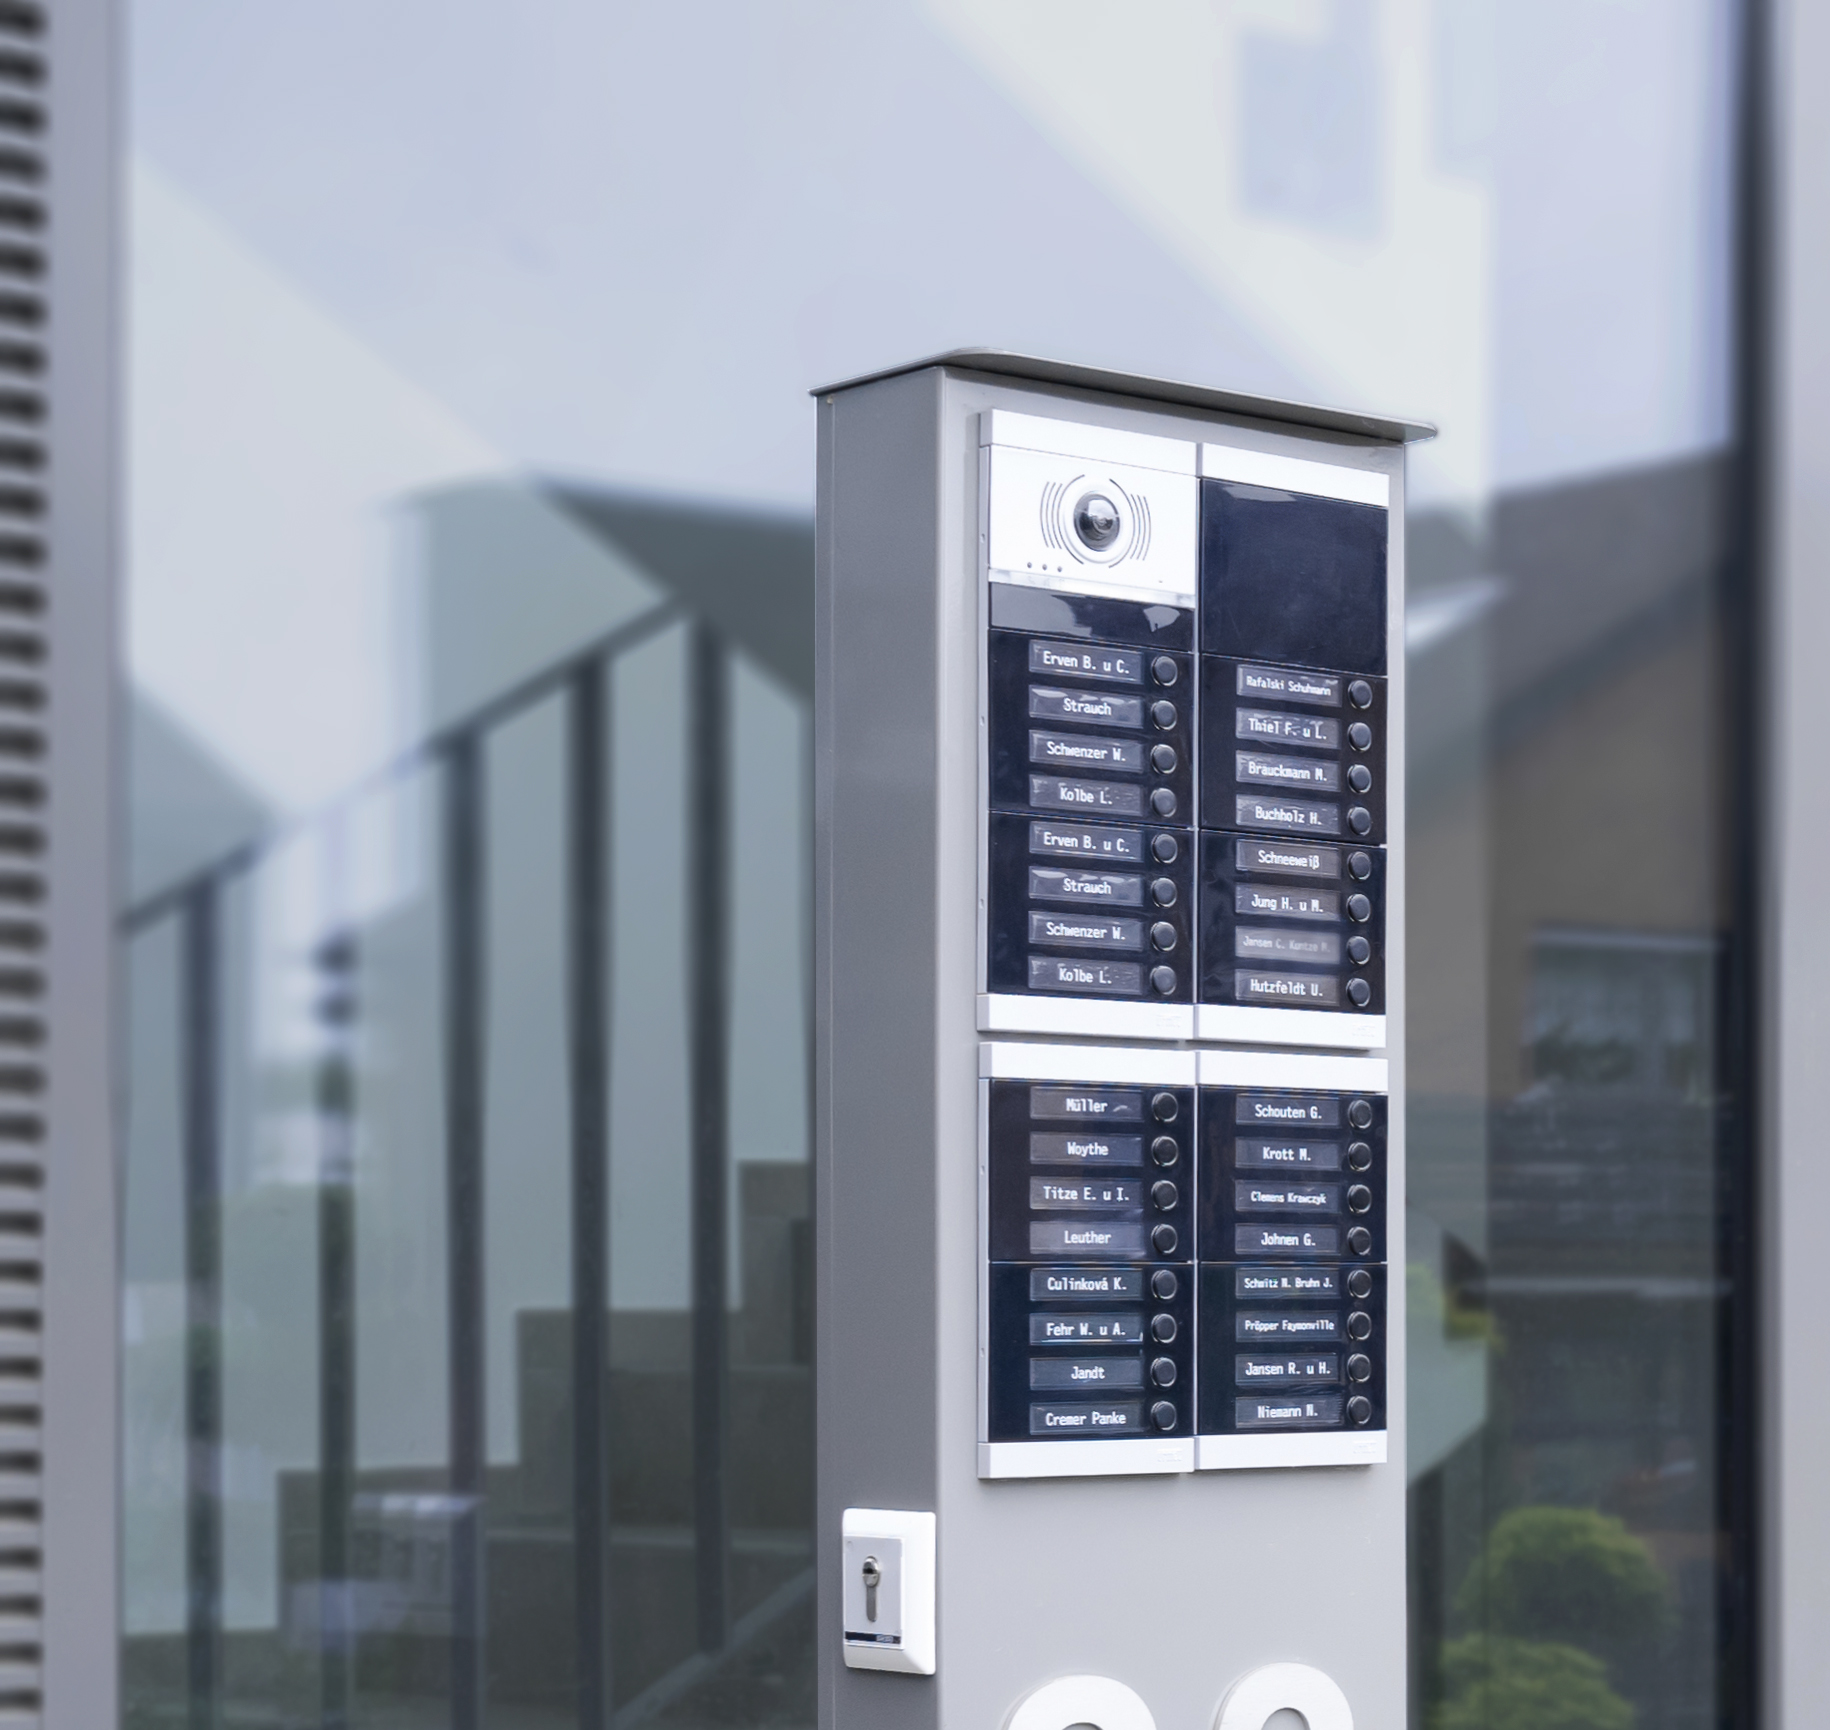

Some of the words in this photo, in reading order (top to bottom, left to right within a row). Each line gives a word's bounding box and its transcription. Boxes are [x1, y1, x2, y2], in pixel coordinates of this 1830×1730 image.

[1043, 651, 1078, 668] Erven
[1083, 655, 1096, 670] B.
[1103, 661, 1111, 671] u
[1116, 659, 1130, 674] C.
[1246, 675, 1285, 690] Rafalski
[1063, 697, 1111, 716] Strauch
[1248, 717, 1279, 734] Thiel
[1303, 729, 1311, 738] u
[1315, 726, 1327, 740] L.
[1047, 741, 1108, 759] Schwenzer
[1112, 747, 1126, 761] W.
[1248, 761, 1311, 780] Brauckmann
[1315, 768, 1327, 782] M.
[1060, 787, 1094, 803] Kolbe
[1100, 791, 1113, 805] L.
[1255, 805, 1305, 824] Buchholz
[1310, 812, 1323, 825] H.
[1043, 832, 1078, 848] Erven
[1083, 836, 1097, 850] B.
[1103, 842, 1111, 851] u
[1117, 840, 1130, 853] C.
[1258, 850, 1320, 869] Schneeweiß
[1063, 877, 1112, 895] Strauch
[1251, 894, 1277, 911] Jung
[1281, 897, 1294, 910] H.
[1299, 901, 1307, 911] u
[1046, 922, 1108, 939] Schwenzer
[1112, 926, 1126, 940] W.
[1058, 967, 1093, 983] Kolbe
[1099, 971, 1112, 984] L.
[1250, 979, 1306, 996] Hutzfeldt
[1311, 984, 1323, 997] U.
[1066, 1098, 1108, 1112] Müller
[1255, 1104, 1306, 1119] Schouten
[1310, 1106, 1322, 1120] G.
[1067, 1141, 1109, 1157] Woythe
[1263, 1146, 1294, 1161] Krott
[1299, 1148, 1311, 1161] M.
[1043, 1186, 1078, 1200] Titze
[1084, 1187, 1097, 1201] E.
[1103, 1191, 1111, 1201] u
[1116, 1187, 1130, 1201] I.
[1250, 1191, 1285, 1203] Clemens
[1287, 1192, 1327, 1205] Krawczyk
[1064, 1230, 1112, 1244] Leuther
[1261, 1232, 1299, 1246] Johnen
[1303, 1233, 1316, 1246] G.
[1113, 1277, 1127, 1290] K.
[1244, 1277, 1279, 1289] Schmitz
[1295, 1278, 1320, 1289] Bruhn
[1322, 1277, 1333, 1289] J.
[1046, 1322, 1075, 1336] Fehr
[1079, 1323, 1093, 1336] W.
[1100, 1326, 1108, 1336] u
[1112, 1322, 1126, 1336] A.
[1244, 1320, 1279, 1332] Pröpper
[1282, 1319, 1335, 1332] Faymonville
[1071, 1366, 1105, 1380] Jandt
[1245, 1362, 1284, 1376] Jansen
[1288, 1362, 1300, 1375] R.
[1306, 1365, 1314, 1375] u
[1319, 1361, 1330, 1375] H.
[1045, 1412, 1087, 1427] Cremer
[1091, 1411, 1127, 1425] Panke
[1257, 1405, 1302, 1419] Niemann
